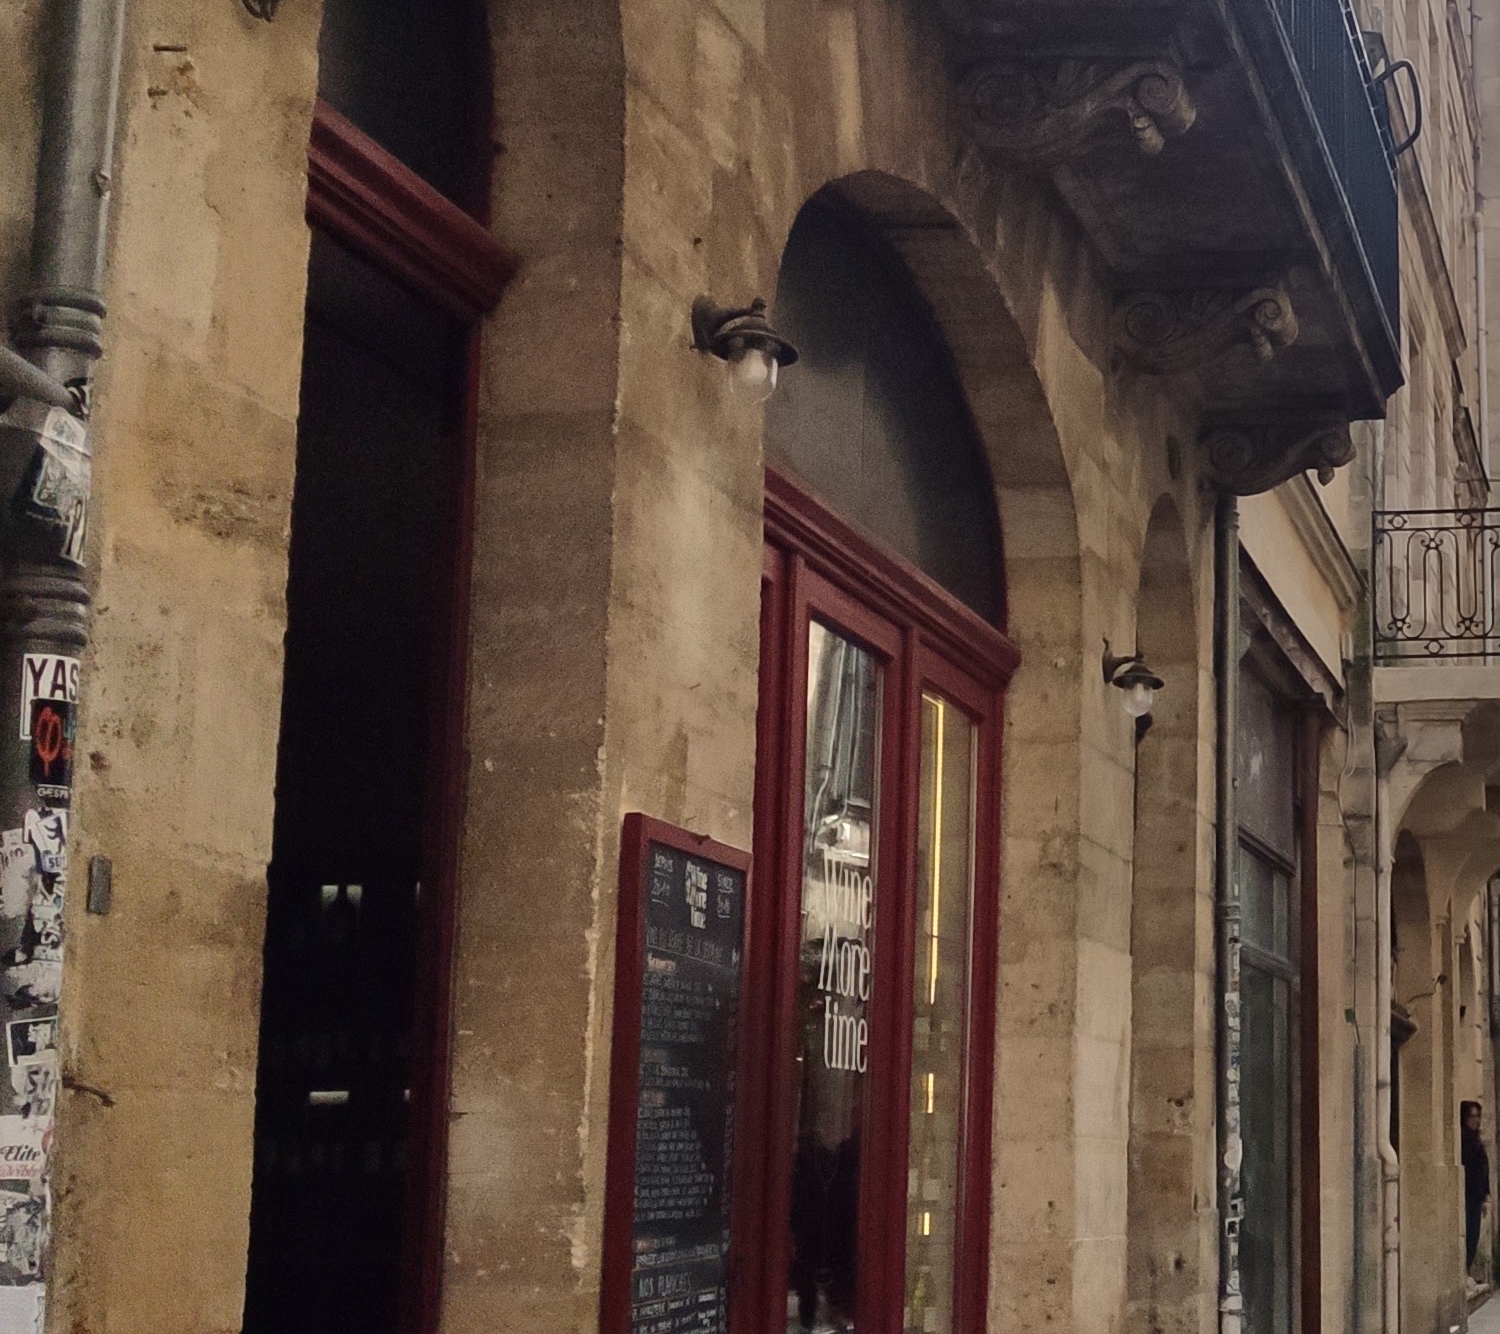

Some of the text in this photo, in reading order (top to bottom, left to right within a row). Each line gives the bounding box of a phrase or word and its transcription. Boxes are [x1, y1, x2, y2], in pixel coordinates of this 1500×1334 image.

[823, 844, 873, 930] Wine
[817, 920, 871, 1002] More
[823, 995, 868, 1073] time
